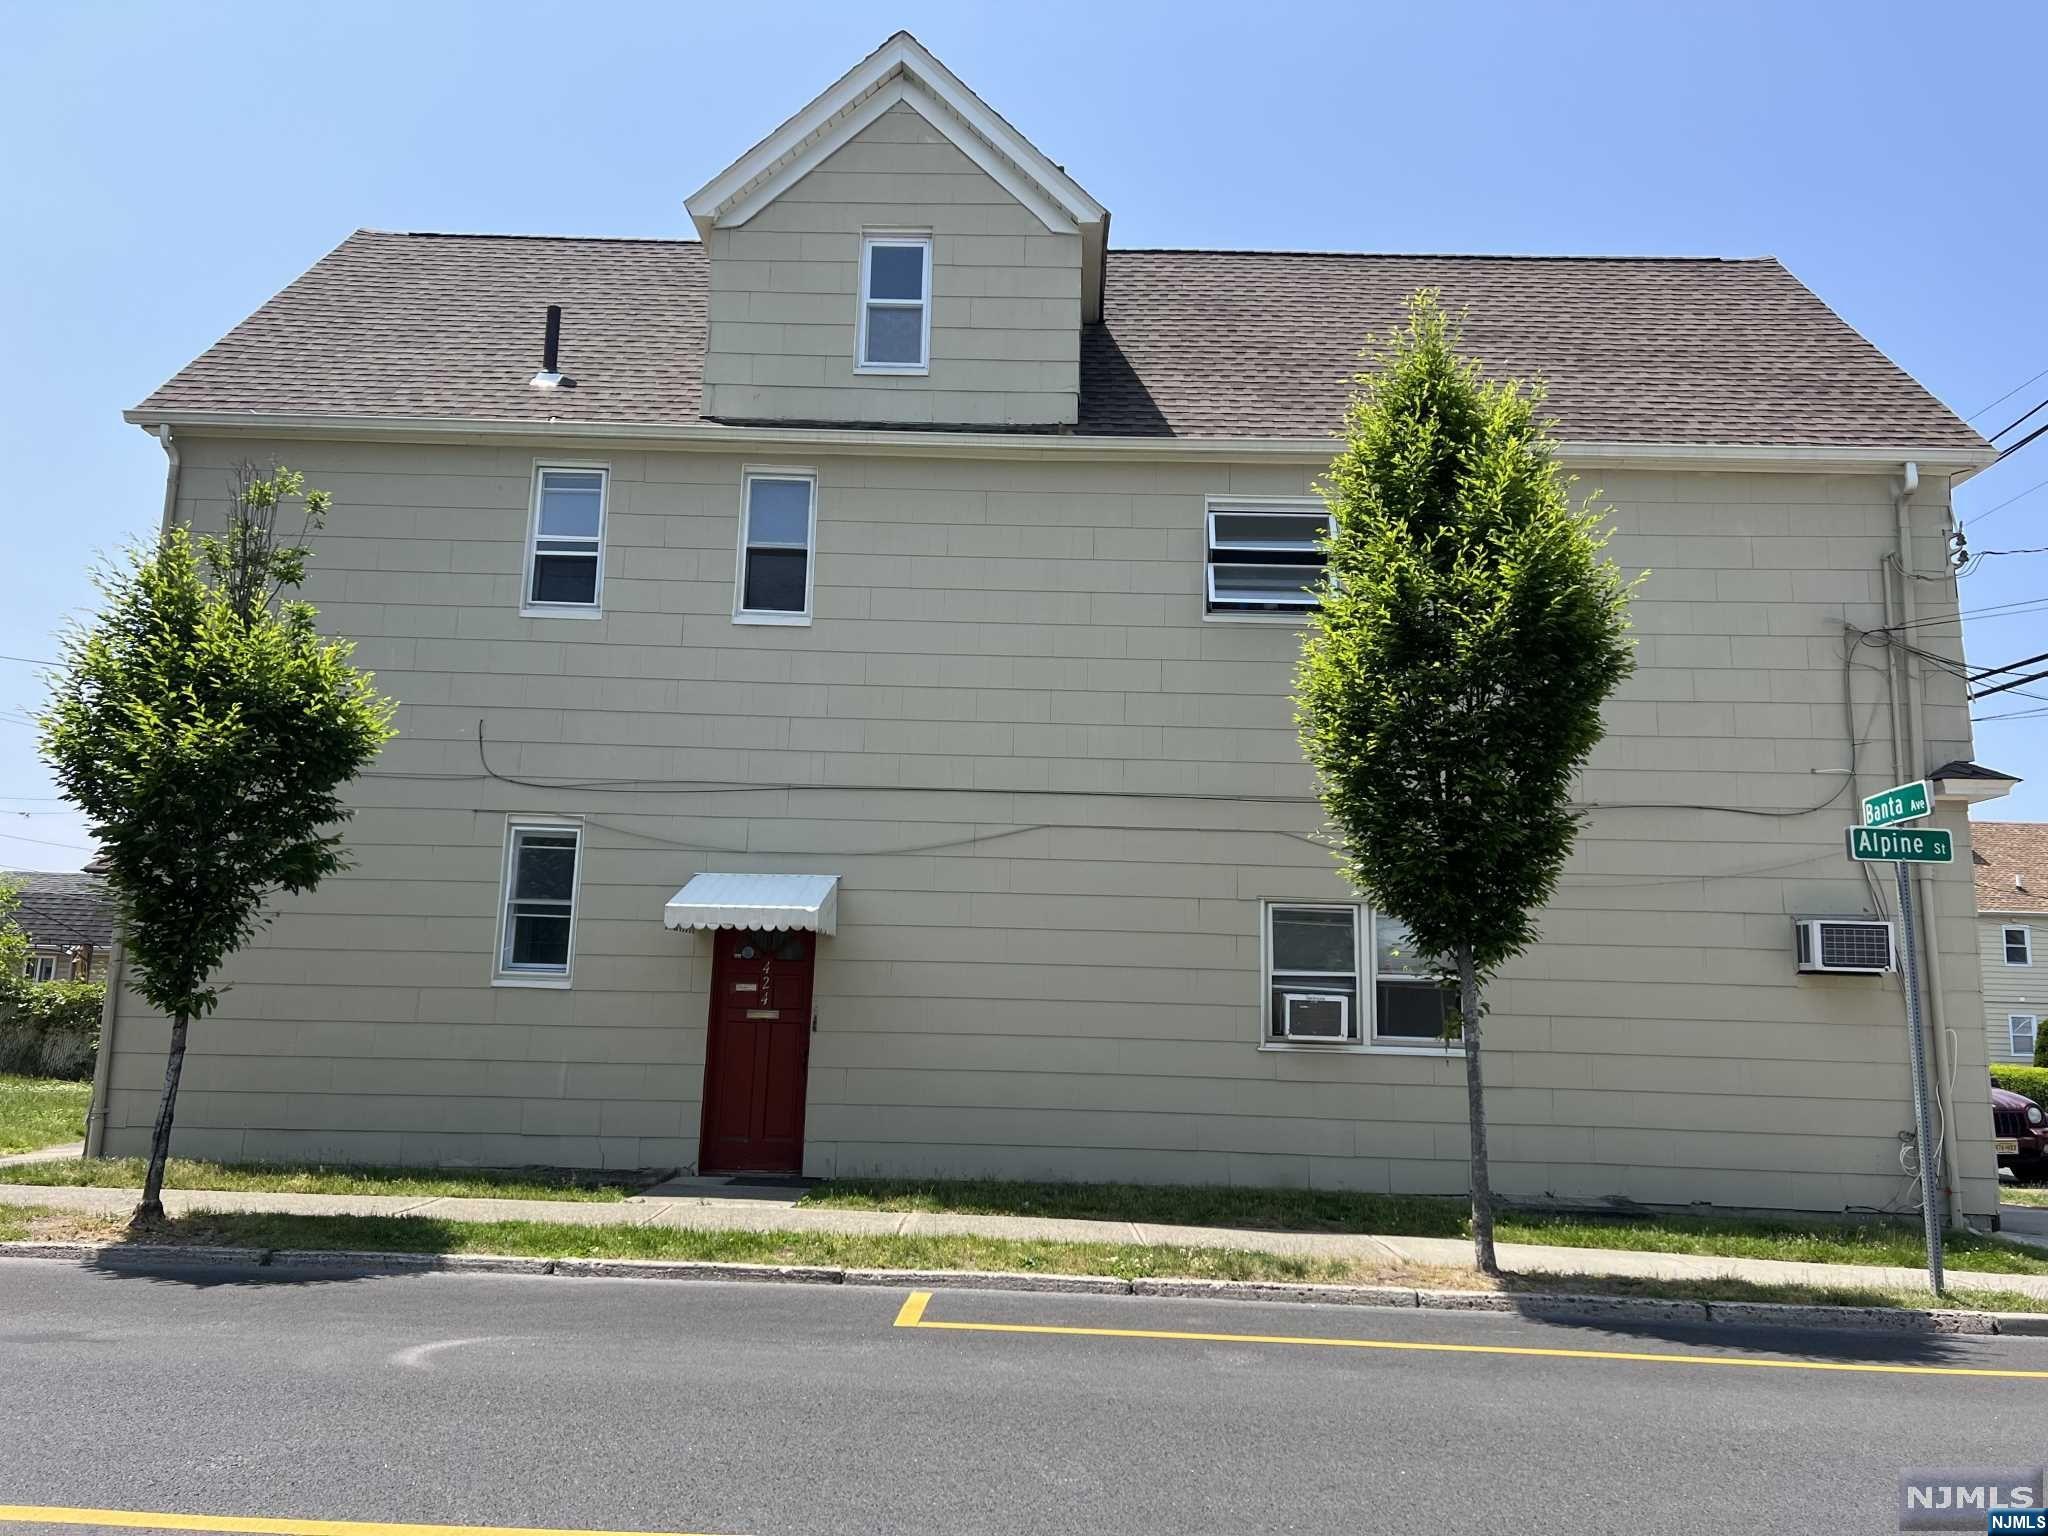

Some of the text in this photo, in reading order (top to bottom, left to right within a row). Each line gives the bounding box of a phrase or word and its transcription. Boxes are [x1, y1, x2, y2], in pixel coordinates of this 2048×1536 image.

[1865, 796, 1925, 824] Banta Ave
[1859, 830, 1946, 857] Alpine St
